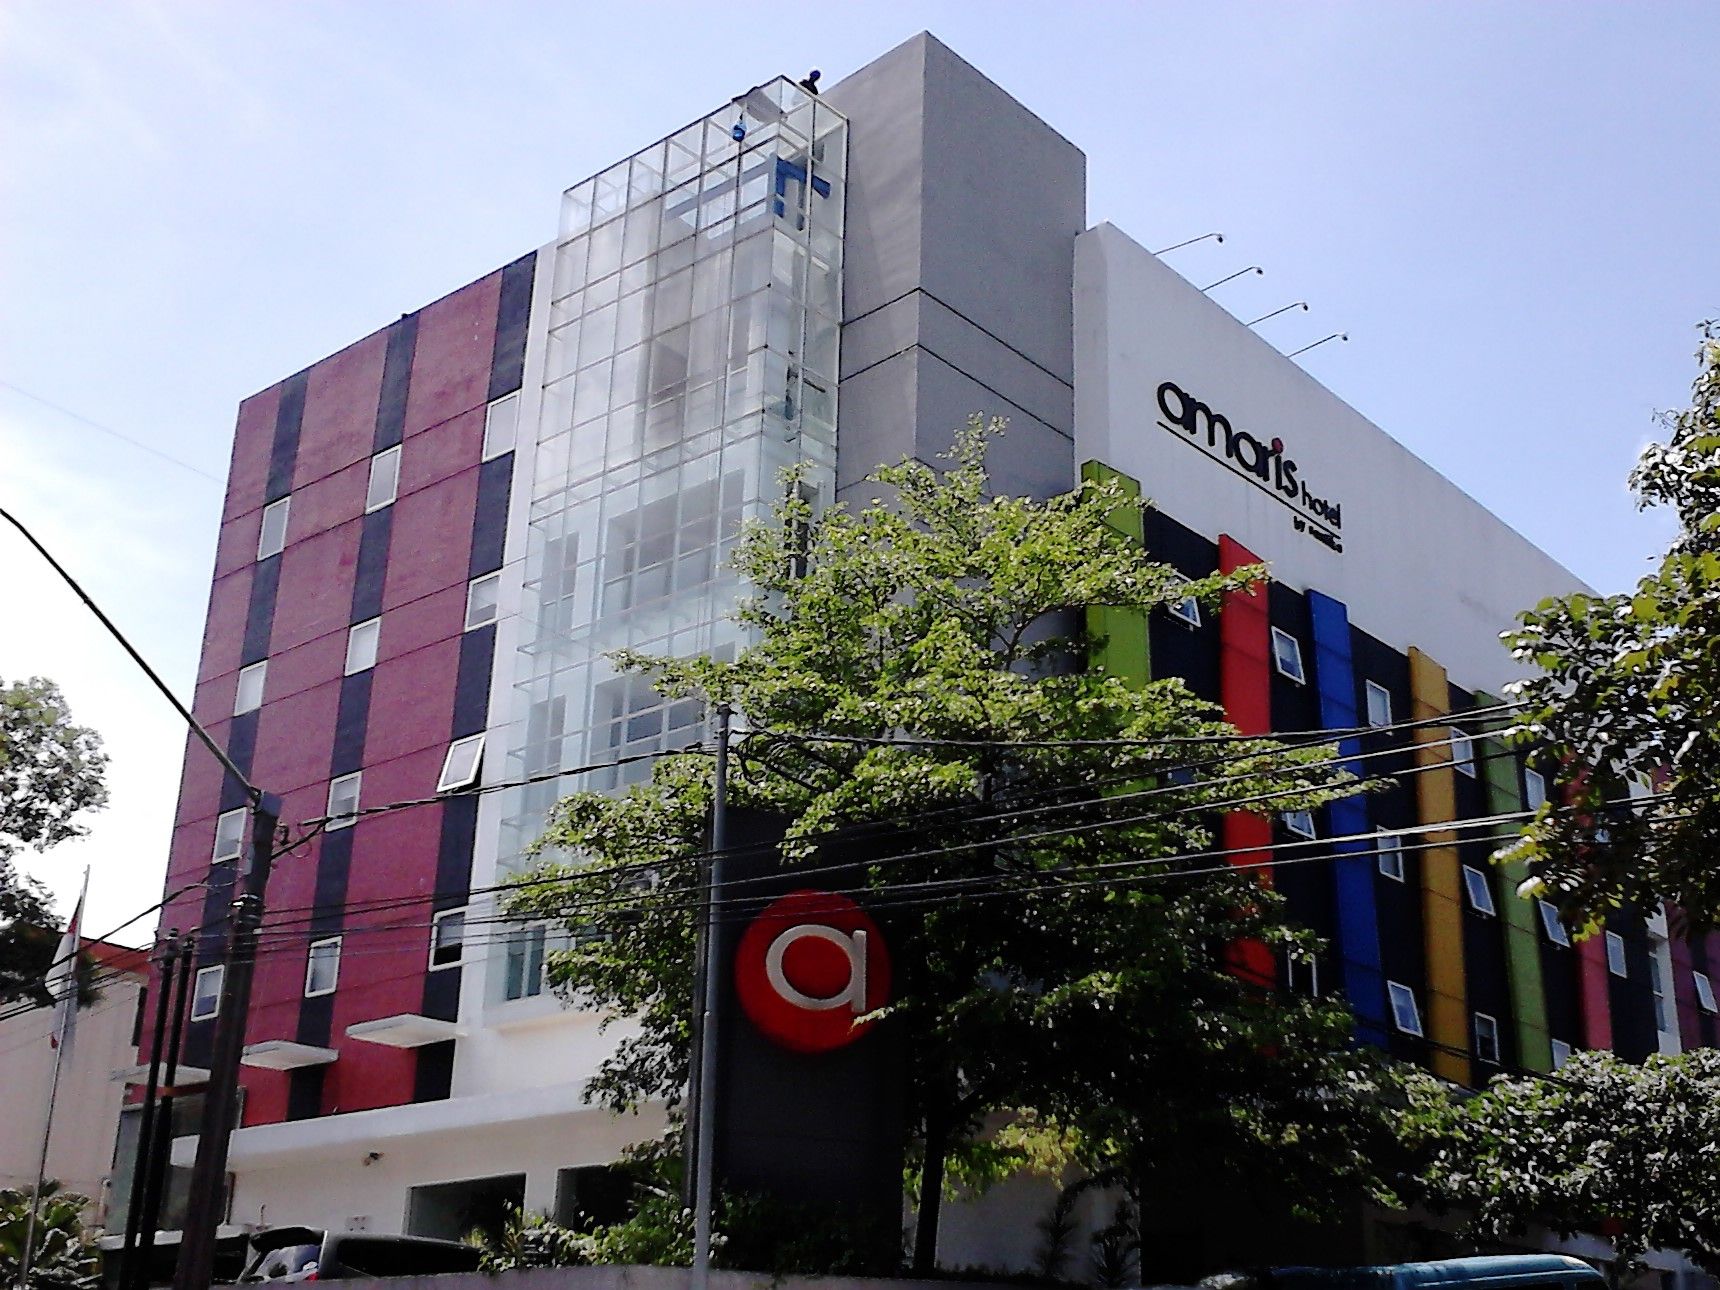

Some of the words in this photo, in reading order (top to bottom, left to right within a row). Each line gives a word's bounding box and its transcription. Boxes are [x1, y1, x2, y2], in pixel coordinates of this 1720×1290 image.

[1157, 381, 1299, 499] amaris
[1301, 480, 1341, 530] hotel
[765, 923, 867, 1013] a
